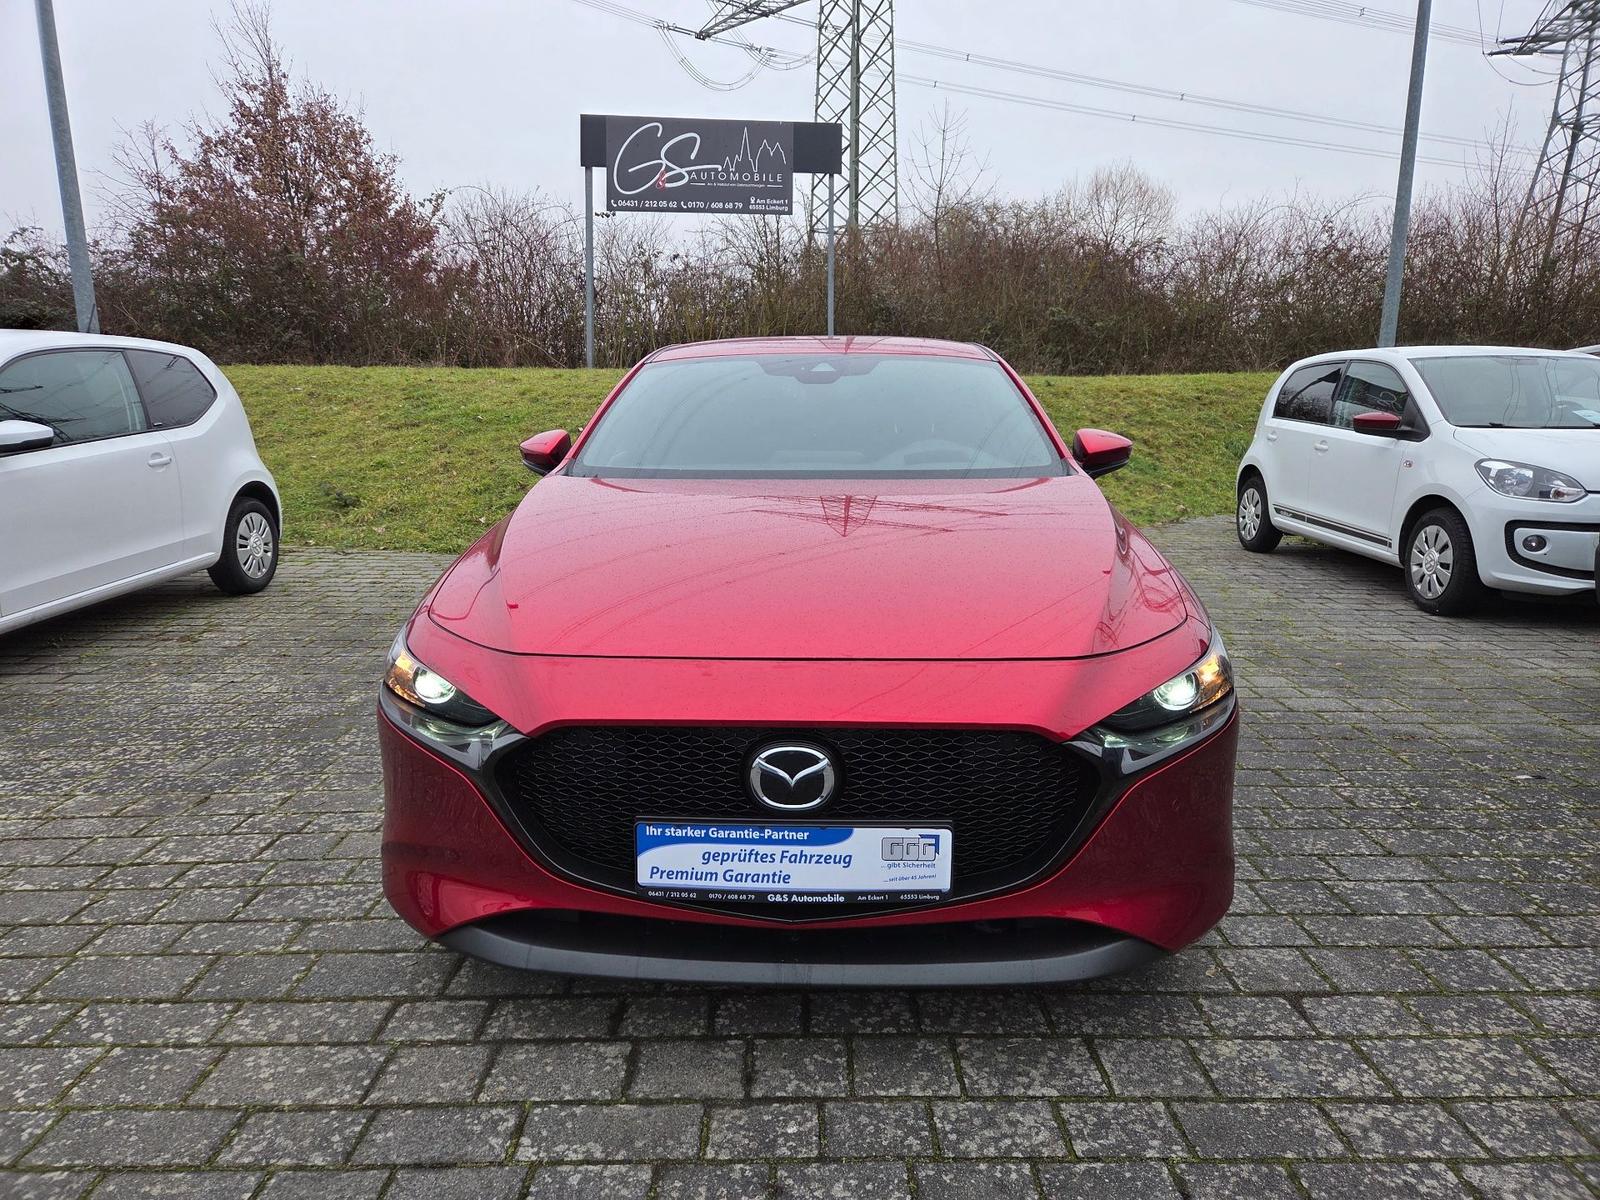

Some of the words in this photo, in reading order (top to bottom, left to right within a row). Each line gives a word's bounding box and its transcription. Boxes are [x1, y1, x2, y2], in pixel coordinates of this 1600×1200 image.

[690, 171, 783, 182] AUTOMOBILE
[645, 200, 658, 208] 212
[687, 201, 705, 209] 0170
[734, 202, 743, 210] 79
[766, 204, 789, 212] Limburg
[646, 825, 663, 836] Ihr
[664, 826, 706, 838] starker
[708, 827, 810, 841] Garantie-Partner
[701, 848, 776, 866] geprüftes
[779, 849, 853, 869] Fahrzeug
[650, 865, 719, 883] Premium
[722, 868, 791, 885] Garantie
[767, 893, 789, 902] G&S
[791, 894, 845, 903] Automobile
